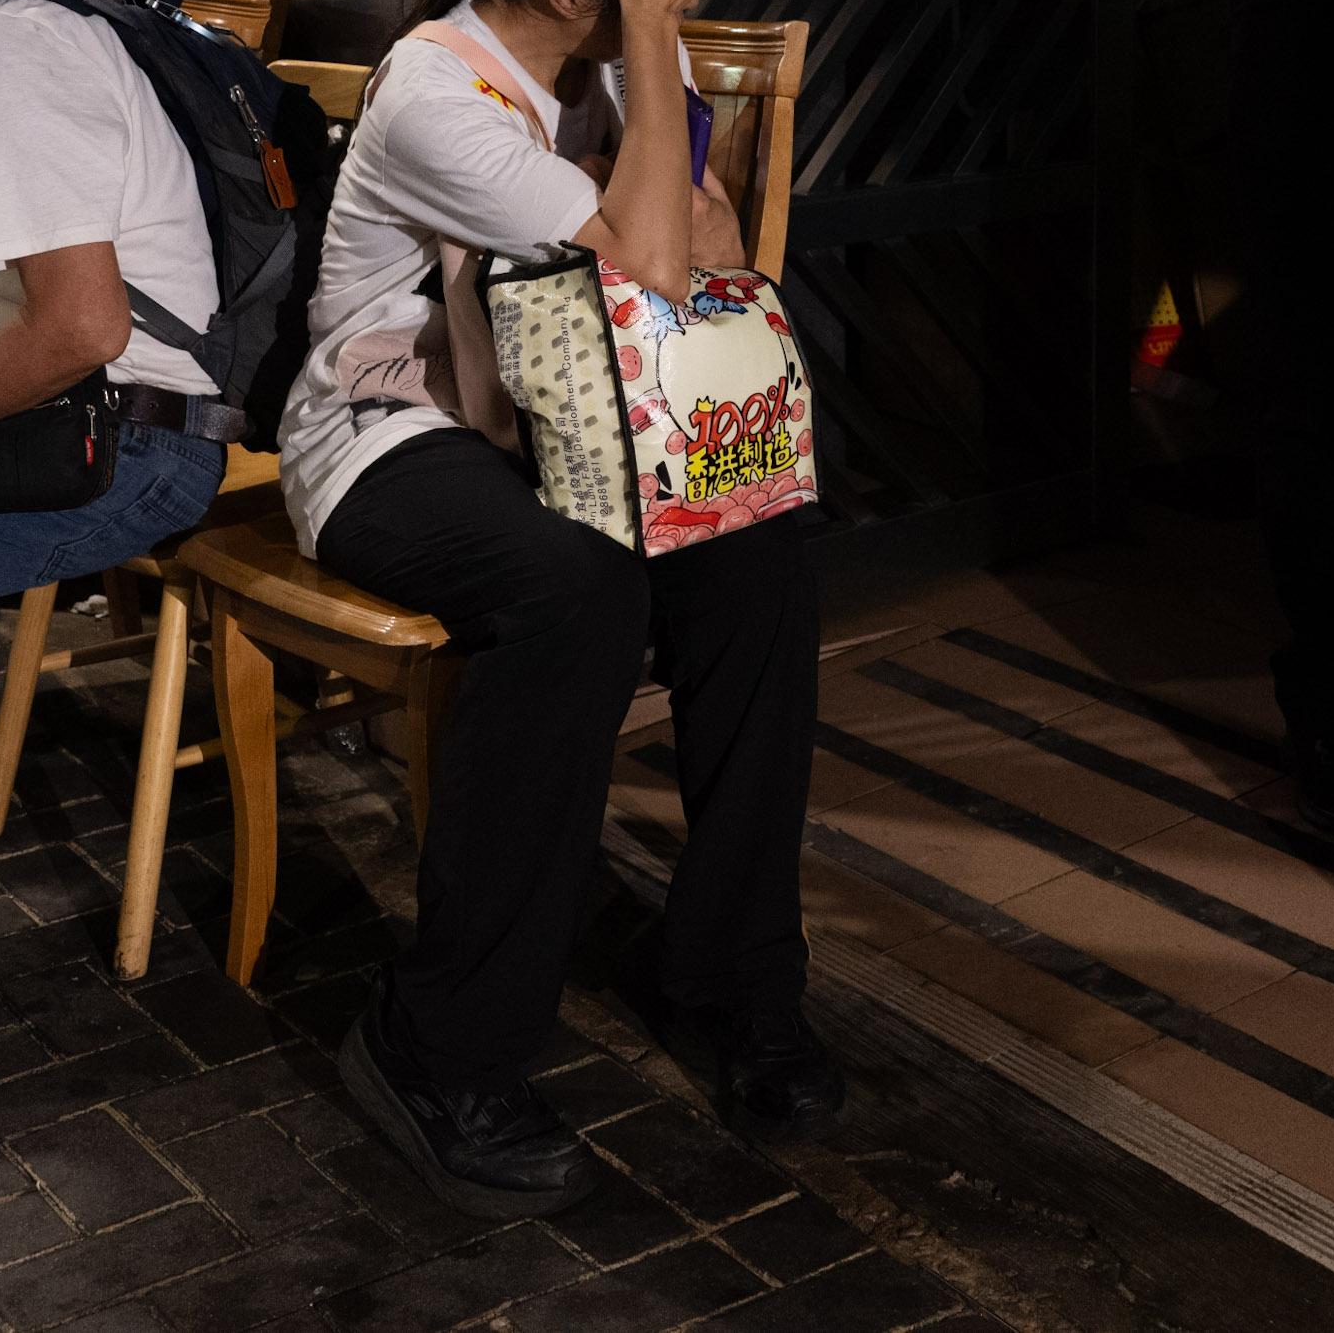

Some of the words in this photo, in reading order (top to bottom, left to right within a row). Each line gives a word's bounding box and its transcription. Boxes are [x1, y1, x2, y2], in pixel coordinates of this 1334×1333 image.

[562, 297, 571, 313] Ltd
[562, 316, 573, 370] Company
[566, 374, 584, 451] Development
[686, 375, 791, 457] 100%
[579, 454, 590, 479] Food
[684, 421, 799, 503] 香港製造
[586, 483, 597, 507] Lung
[598, 488, 609, 515] 2868
